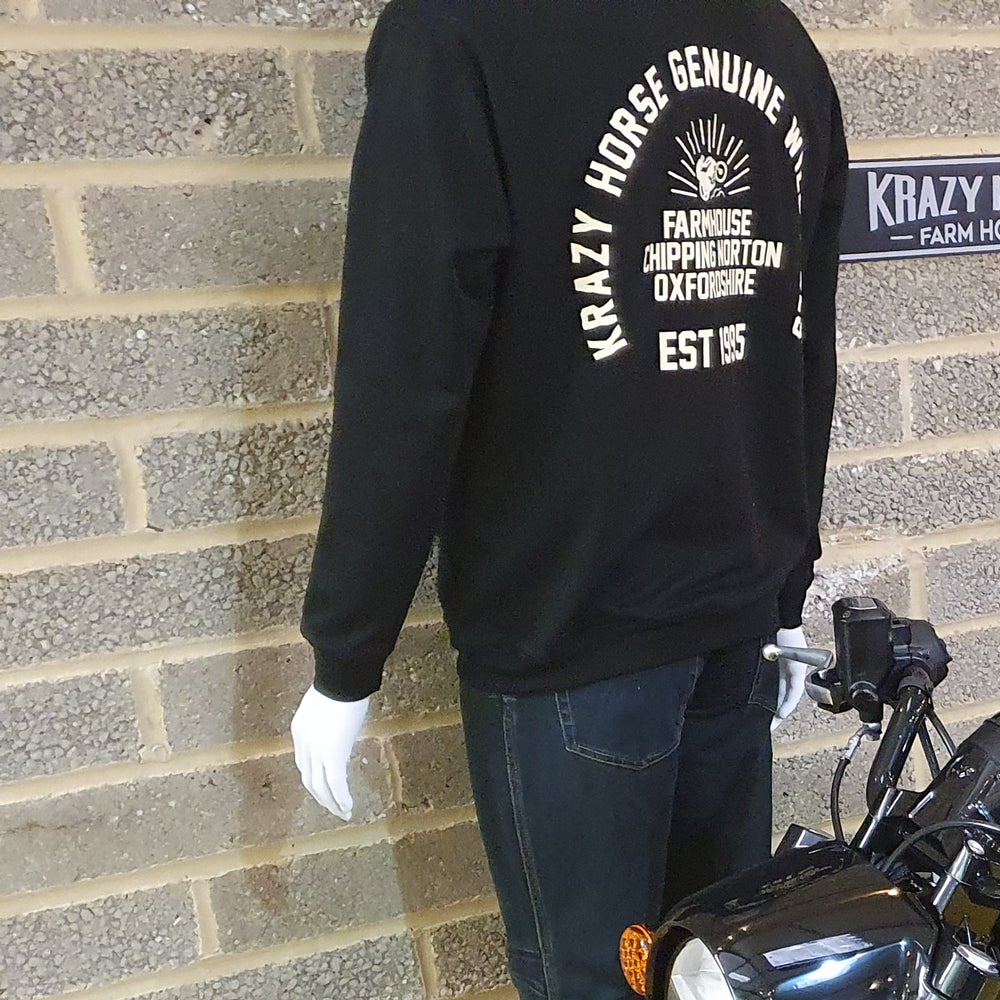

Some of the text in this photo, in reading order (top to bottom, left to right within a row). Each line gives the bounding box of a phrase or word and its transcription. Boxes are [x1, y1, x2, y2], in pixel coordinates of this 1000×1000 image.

[667, 45, 785, 125] GENUINE
[584, 65, 669, 198] HORSE
[867, 171, 983, 232] KRAZY
[663, 208, 753, 239] FARMHOUSE
[920, 221, 974, 246] FARM
[643, 238, 783, 274] CHIPPING NORTON
[571, 207, 628, 361] KRAZY
[654, 268, 757, 302] OXFORDSHIRE
[658, 328, 714, 371] EST
